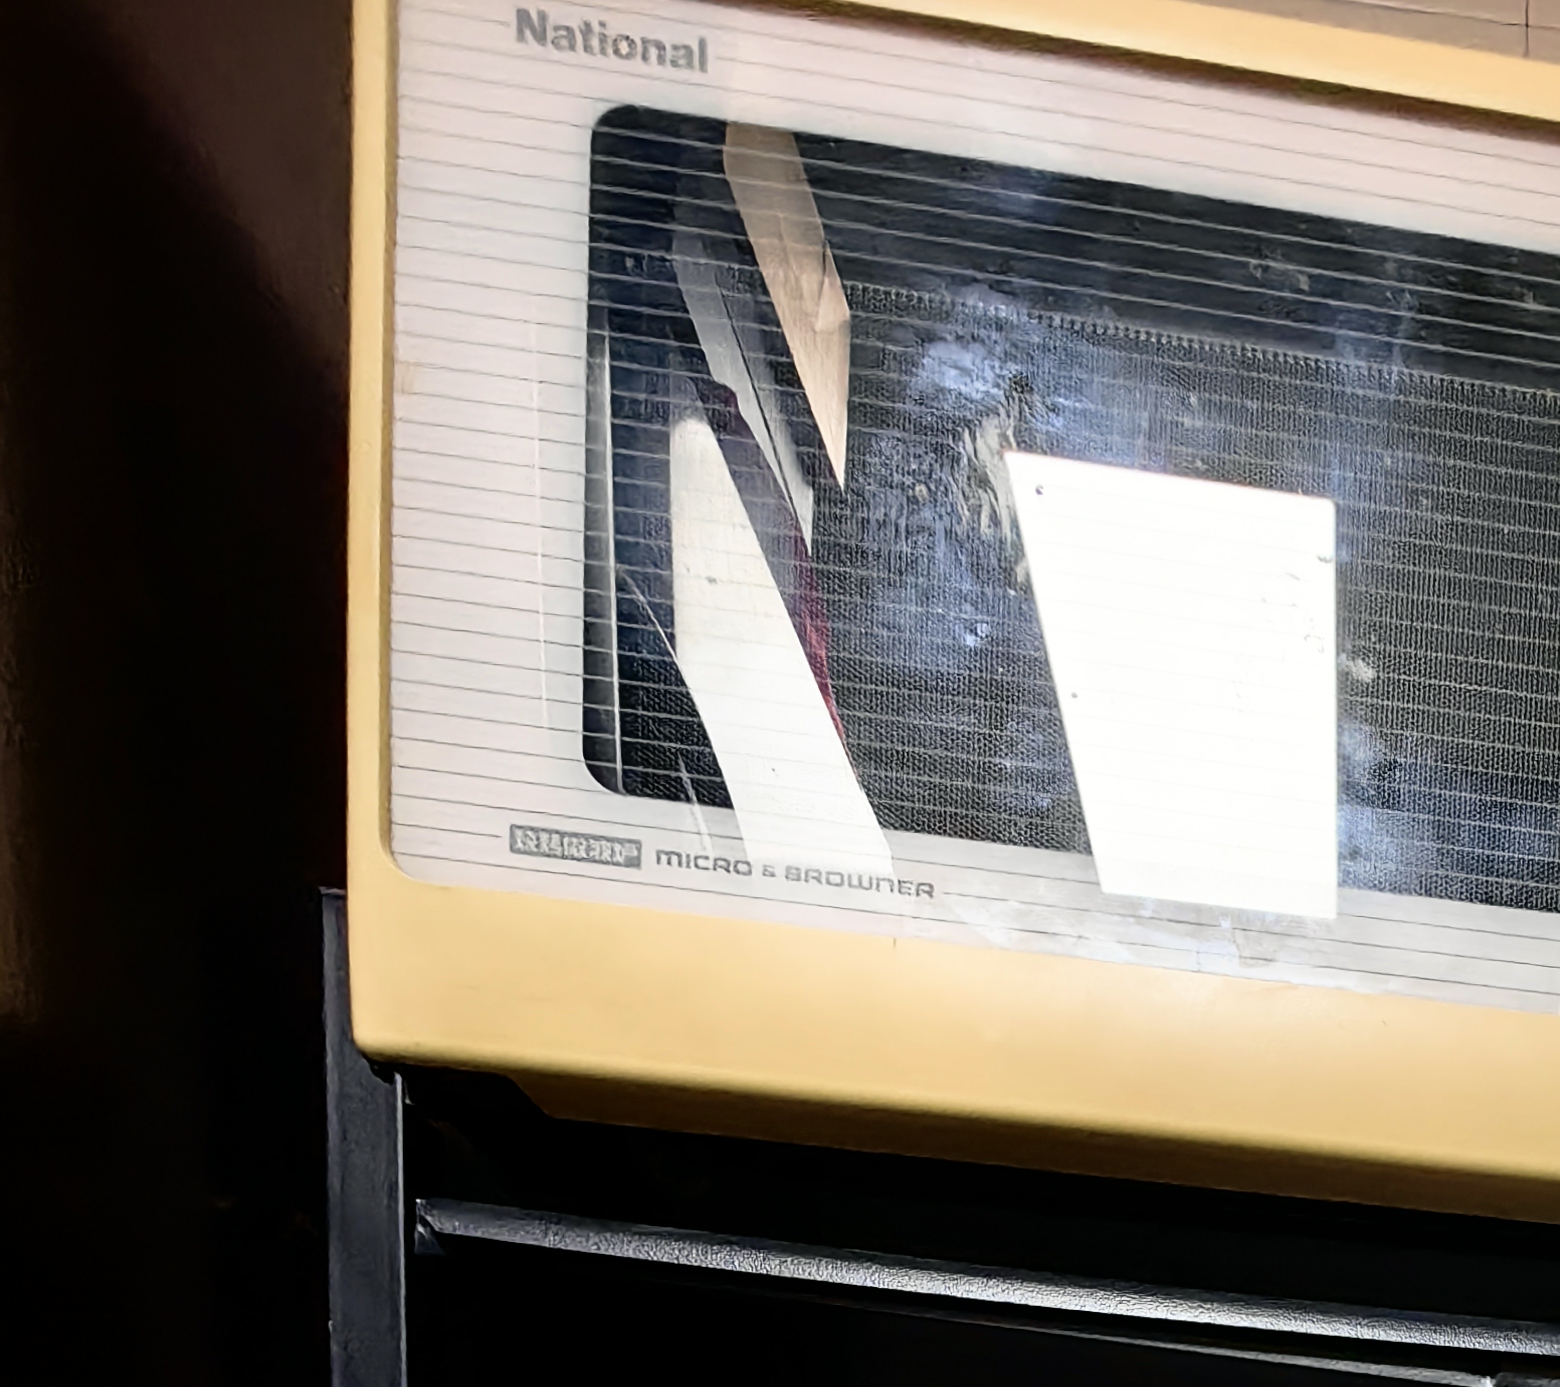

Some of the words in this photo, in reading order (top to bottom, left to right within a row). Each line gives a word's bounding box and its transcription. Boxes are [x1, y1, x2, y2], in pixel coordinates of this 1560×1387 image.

[515, 7, 709, 74] National
[655, 848, 753, 877] MICRO
[761, 864, 777, 878] &
[784, 865, 935, 899] BROWNER
